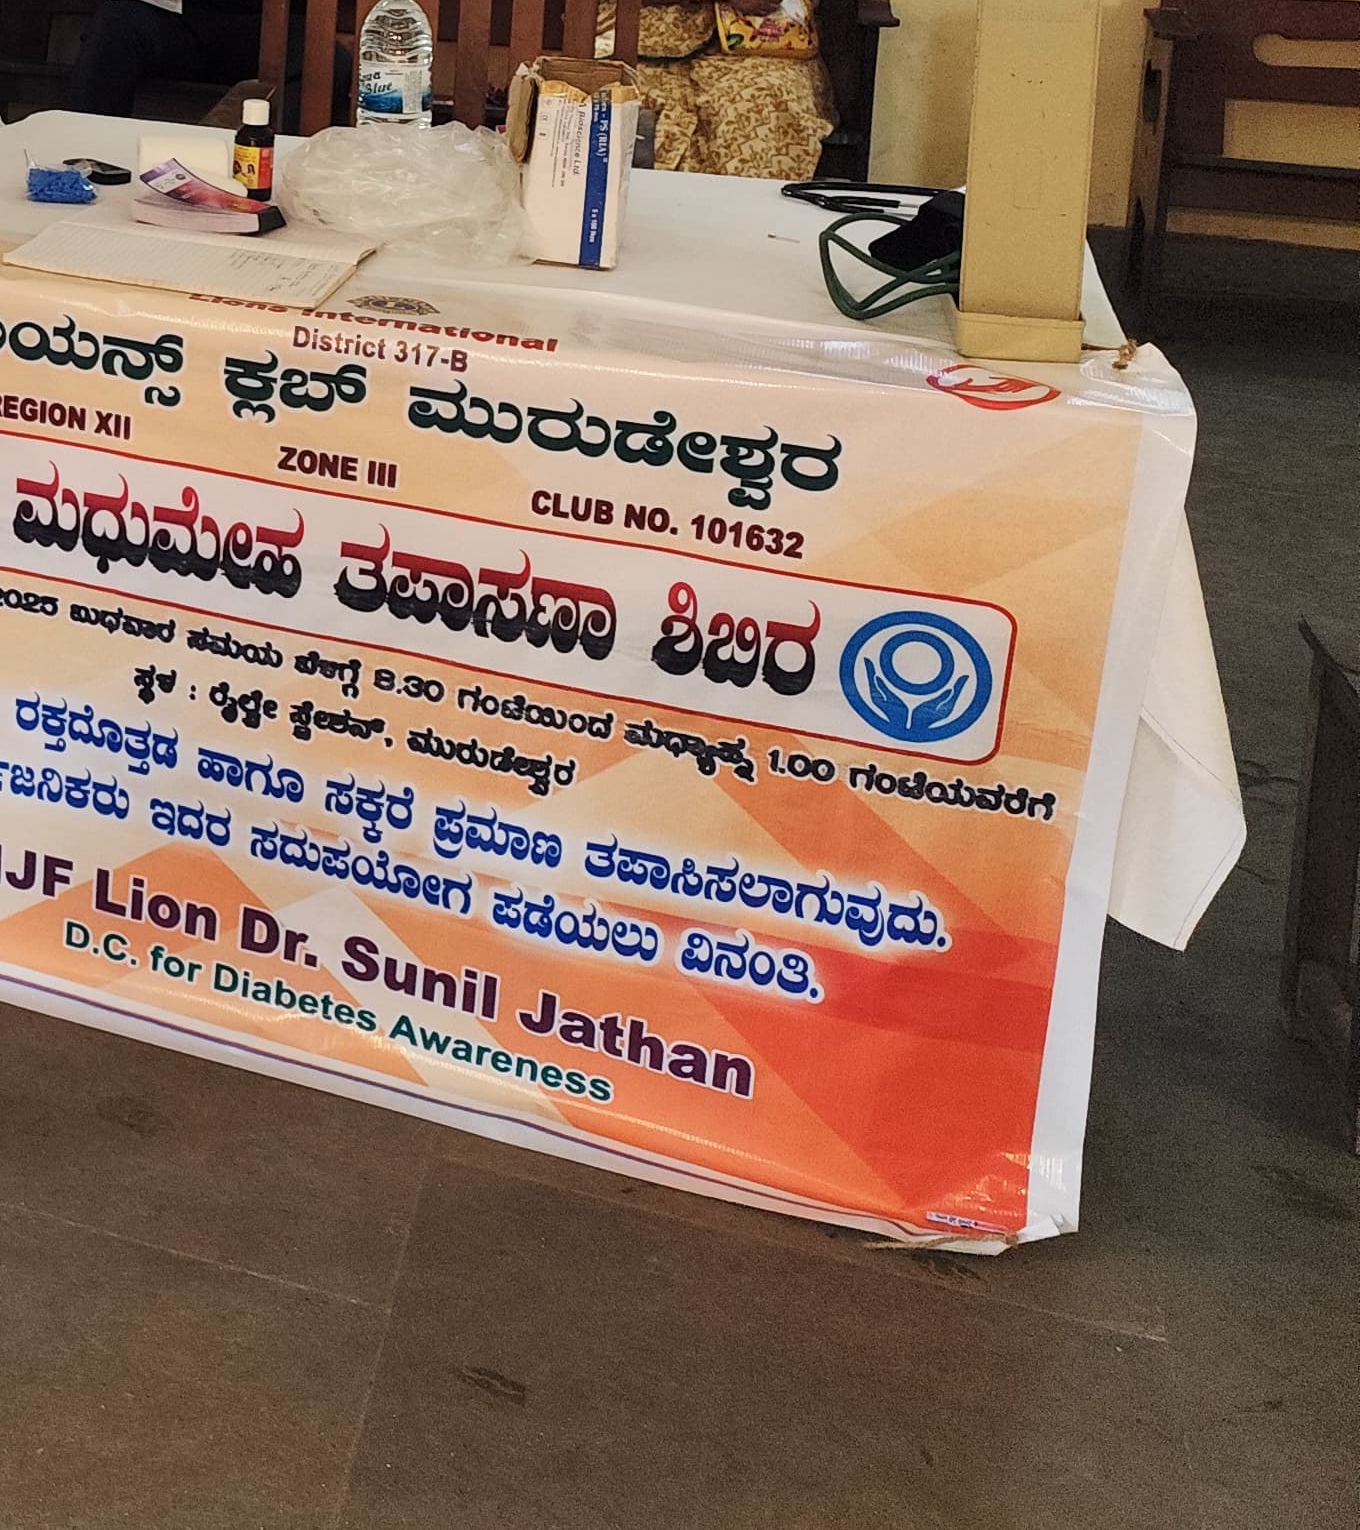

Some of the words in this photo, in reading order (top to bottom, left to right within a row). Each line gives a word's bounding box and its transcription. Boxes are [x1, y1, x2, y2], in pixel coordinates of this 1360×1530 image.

[292, 324, 387, 361] District
[393, 337, 468, 374] 317-B
[300, 307, 559, 353] International
[94, 406, 131, 441] XII
[222, 348, 367, 424] ಕ್ಲಬ್
[407, 378, 843, 510] ಮುರುಡೇಶ್ವರ
[278, 445, 359, 483] ZONE
[367, 460, 397, 490] III
[13, 459, 305, 599] ಮಧುಮೇಹ
[336, 506, 618, 663] ತಪಾಸಣಾ
[652, 577, 822, 696] ಶಿಬಿರ
[531, 489, 615, 526] CLUB
[623, 503, 679, 536] NO.
[690, 513, 805, 561] 101632
[70, 601, 176, 644] ಬುಧವಾರ
[186, 626, 281, 669] ಸಮಯ
[373, 667, 446, 704] 8.30
[457, 684, 614, 741] ಗಂಟೆಯಿಂದ
[767, 747, 837, 783] 1.00
[848, 760, 1057, 821] ಗಂಟೆಯವರೆಗೆ
[406, 726, 577, 797] ಮುರುಡೇಶ್ವರ
[15, 692, 178, 774] ರಕ್ತದೊತ್ತಡ
[197, 744, 305, 803] ಹಾಗೂ
[324, 772, 414, 844] ಸಕ್ಕರೆ
[432, 797, 564, 869] ಪ್ರಮಾಣ
[584, 830, 950, 951] ತಪಾಸಿಸಲಾಗುವುದು.
[148, 794, 233, 847] ಇದರ
[248, 824, 474, 916] ಸದುಪಯೋಗ
[491, 888, 662, 963] ಪಡೆಯಲು
[679, 930, 822, 1004] ವಿನಂತಿ.
[63, 919, 137, 966] D.C.
[149, 944, 198, 986] for
[212, 963, 378, 1033] Diabetes
[388, 1013, 614, 1104] Awareness
[93, 865, 219, 944] Lion
[238, 906, 320, 968] Dr.
[342, 935, 498, 1022] Sunil
[518, 972, 756, 1100] Jathan
